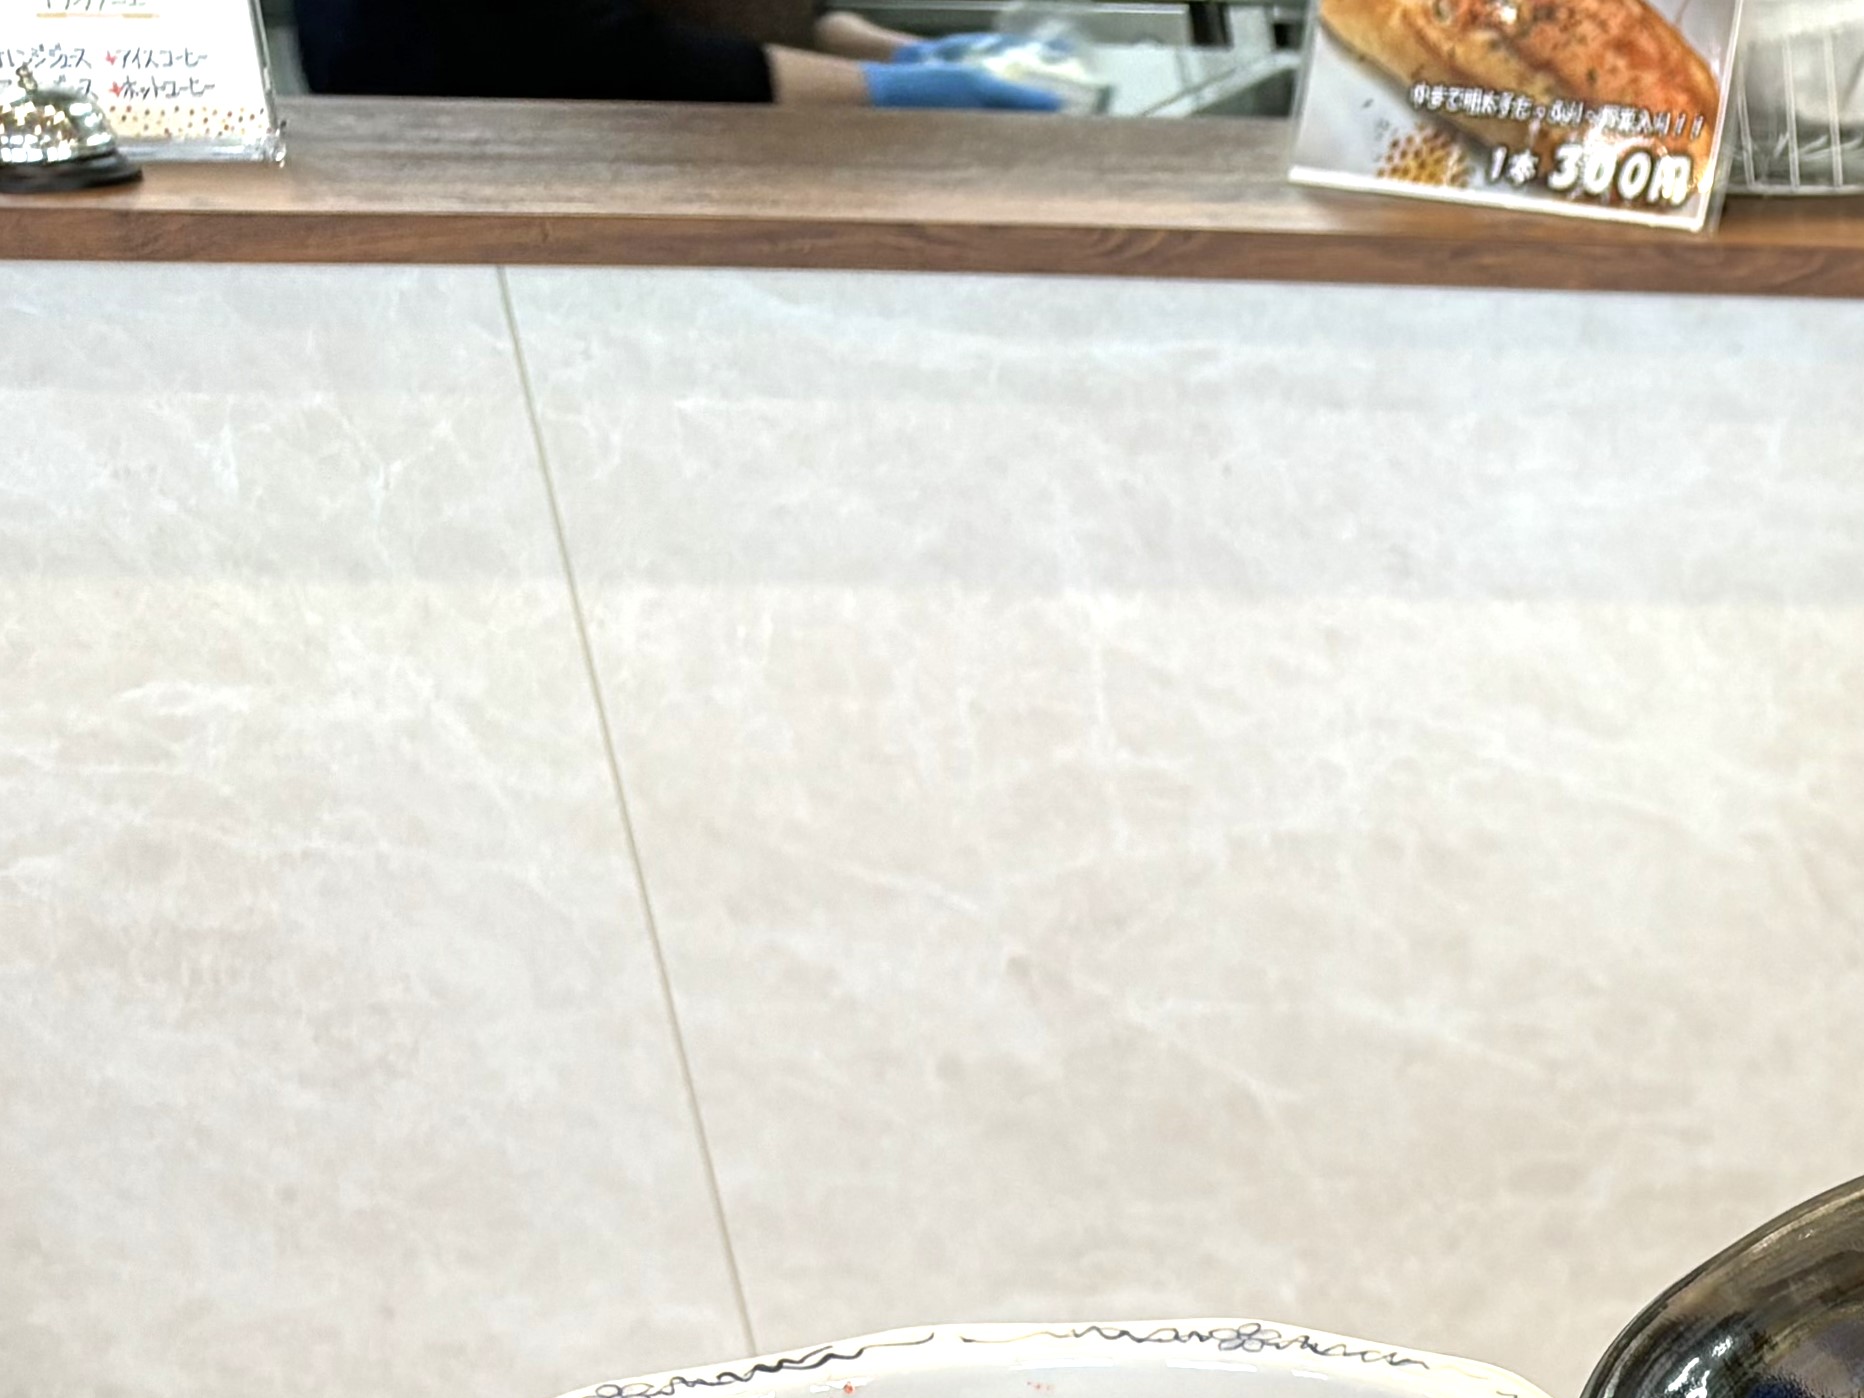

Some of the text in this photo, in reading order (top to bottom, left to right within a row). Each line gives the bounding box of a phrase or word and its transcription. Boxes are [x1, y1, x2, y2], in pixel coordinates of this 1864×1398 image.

[0, 43, 208, 69] レンジジュース アイスコーヒー
[122, 75, 215, 99] ホットコーヒー
